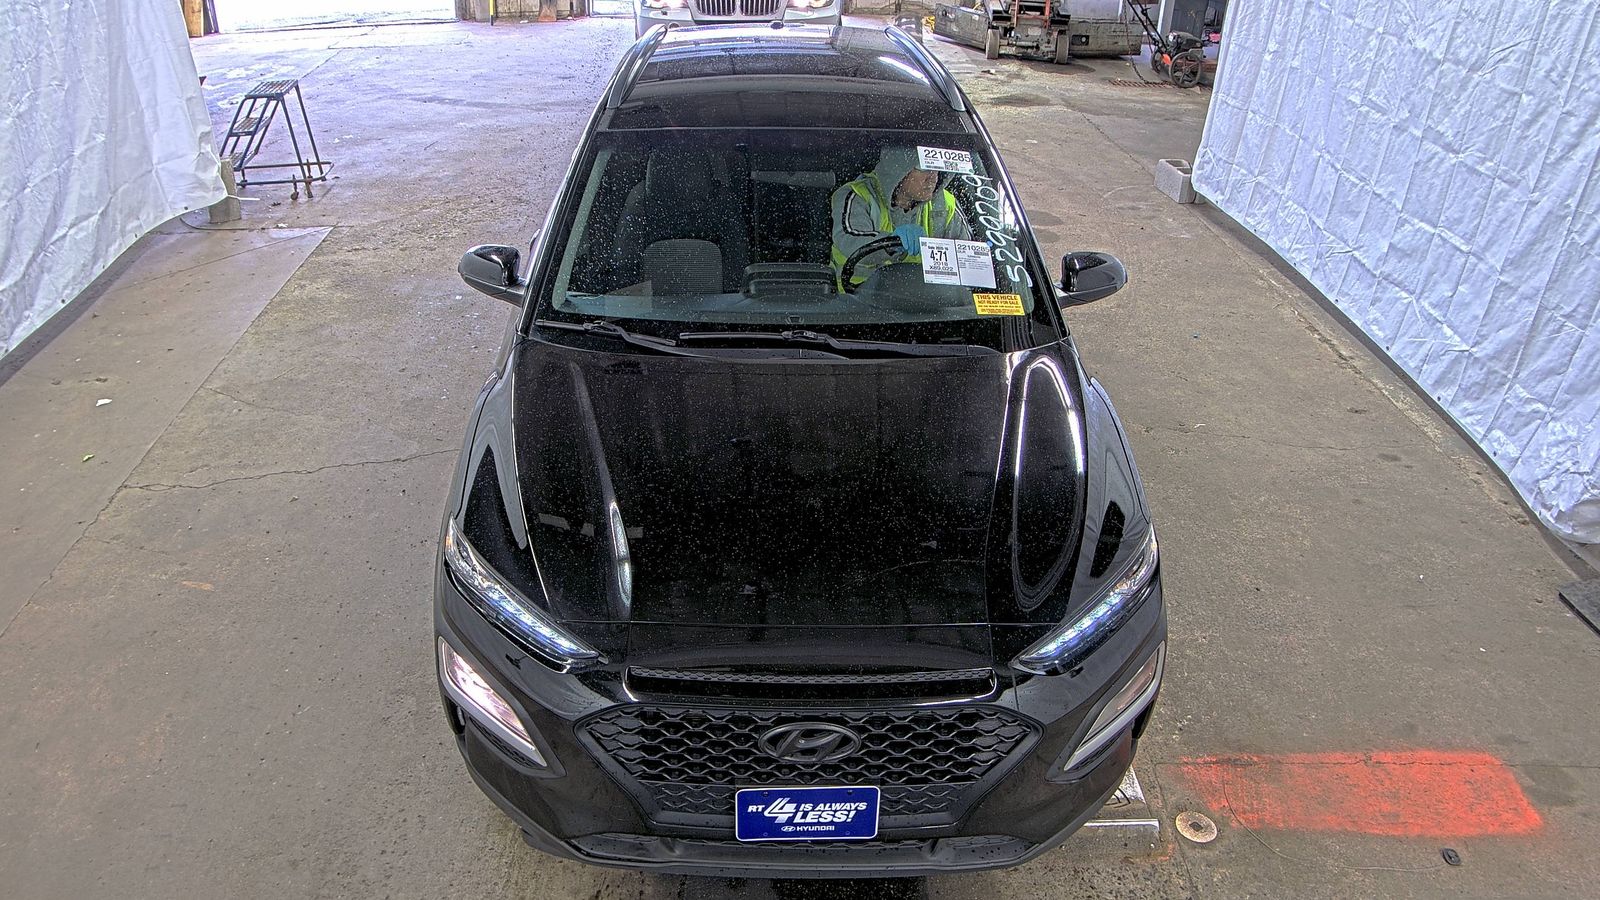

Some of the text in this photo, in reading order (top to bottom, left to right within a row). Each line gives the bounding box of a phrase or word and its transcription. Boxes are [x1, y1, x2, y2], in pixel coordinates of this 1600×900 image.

[924, 149, 970, 162] 2210285
[957, 244, 989, 252] 2210285
[930, 250, 948, 261] 4:71
[764, 798, 797, 823] 4
[814, 802, 868, 811] ALWAYS
[793, 811, 857, 823] LESS!
